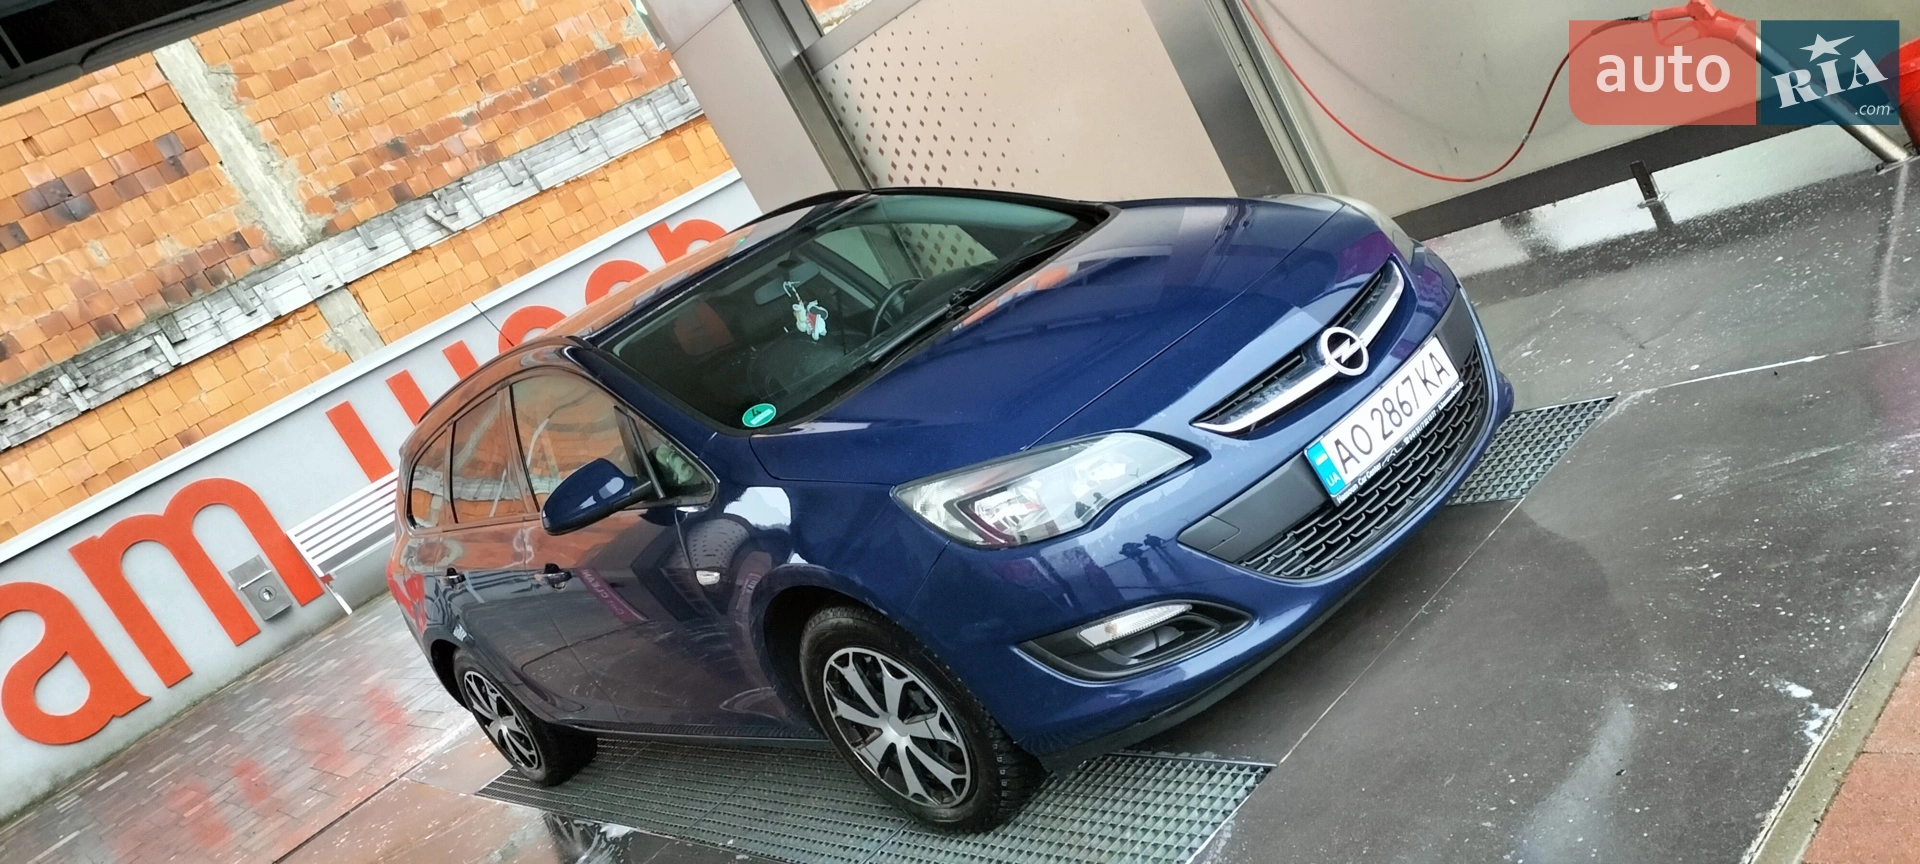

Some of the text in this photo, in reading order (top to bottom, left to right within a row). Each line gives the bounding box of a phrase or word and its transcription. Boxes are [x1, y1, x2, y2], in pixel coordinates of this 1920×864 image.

[1334, 424, 1373, 474] AO
[1370, 375, 1420, 441] 2867
[1415, 352, 1450, 396] KA
[1325, 471, 1341, 487] UA
